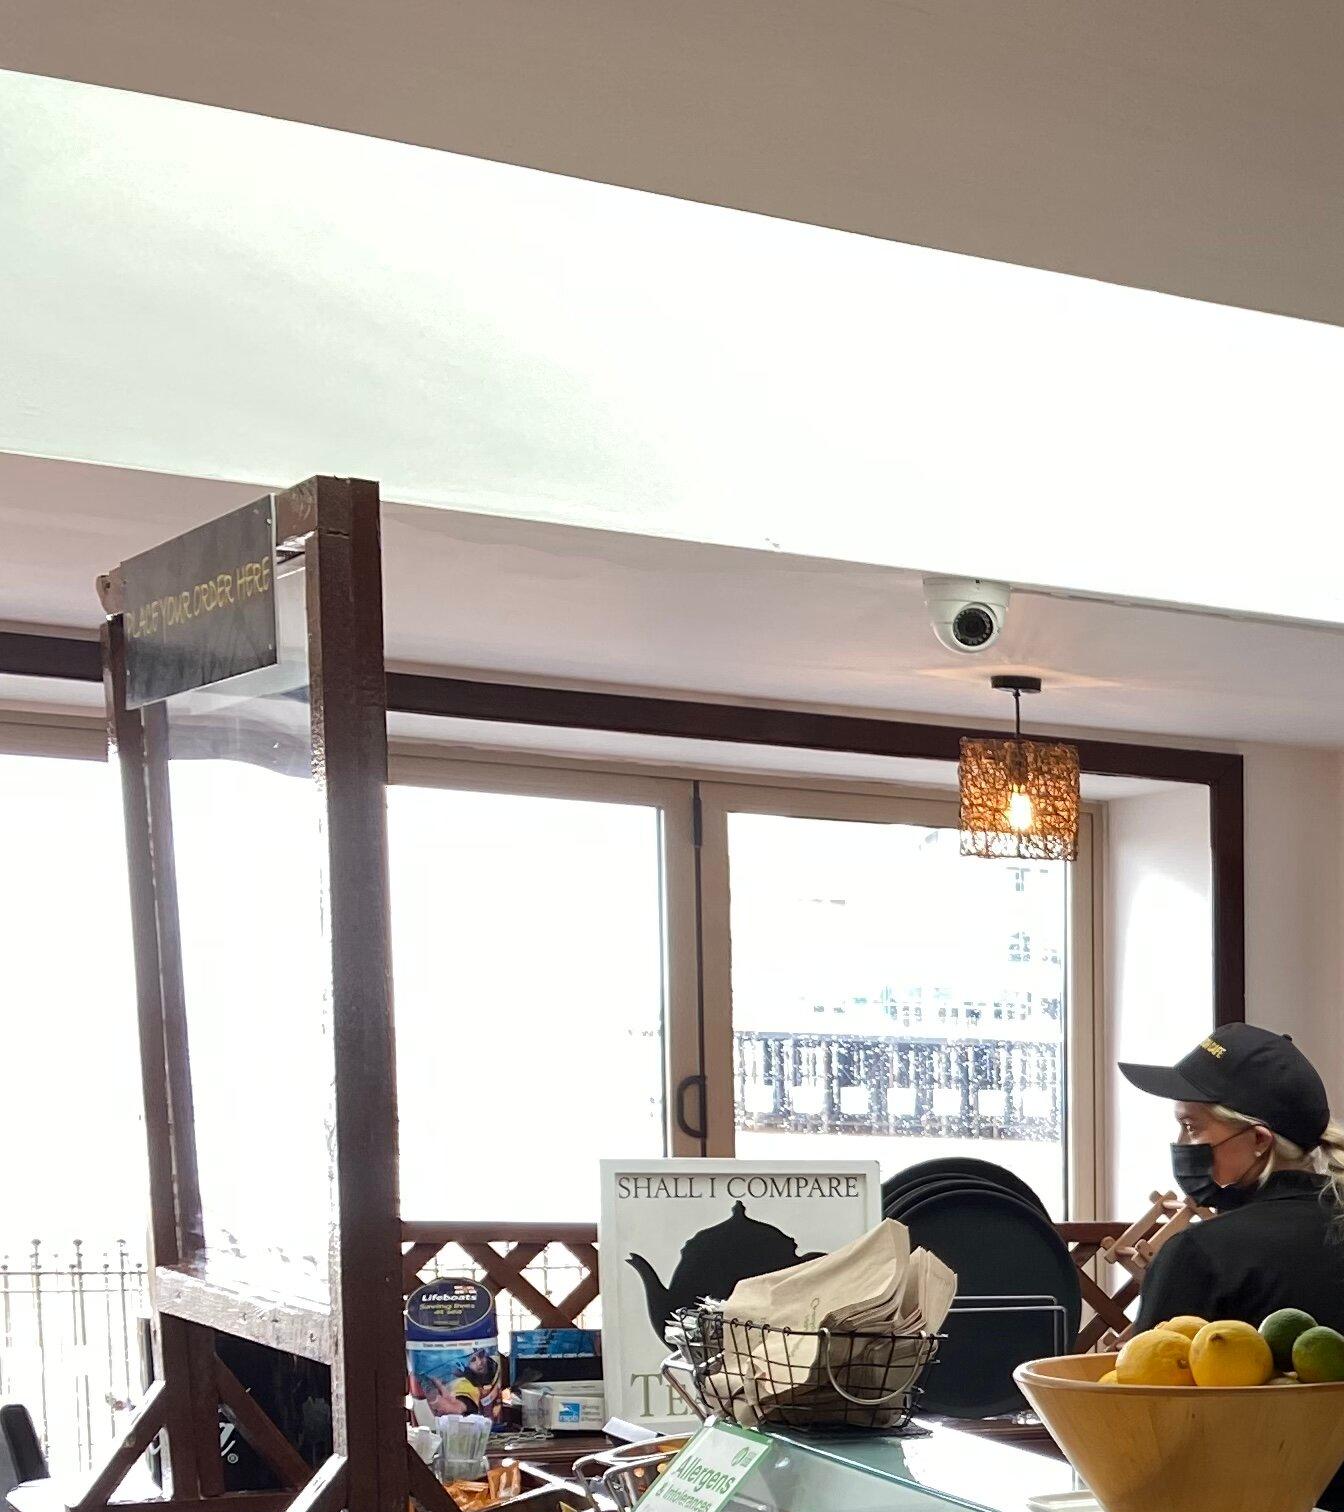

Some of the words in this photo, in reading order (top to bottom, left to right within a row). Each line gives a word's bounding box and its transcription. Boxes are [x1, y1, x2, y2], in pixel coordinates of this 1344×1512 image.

[159, 591, 192, 643] YOUR
[194, 573, 234, 616] ORDER
[236, 556, 271, 600] HERE
[618, 1176, 703, 1199] SHALL
[709, 1177, 717, 1198] I
[727, 1175, 859, 1199] COMPARE
[421, 1293, 477, 1302] Lifeboats
[630, 1372, 704, 1418] TE
[671, 1455, 737, 1496] Allergens
